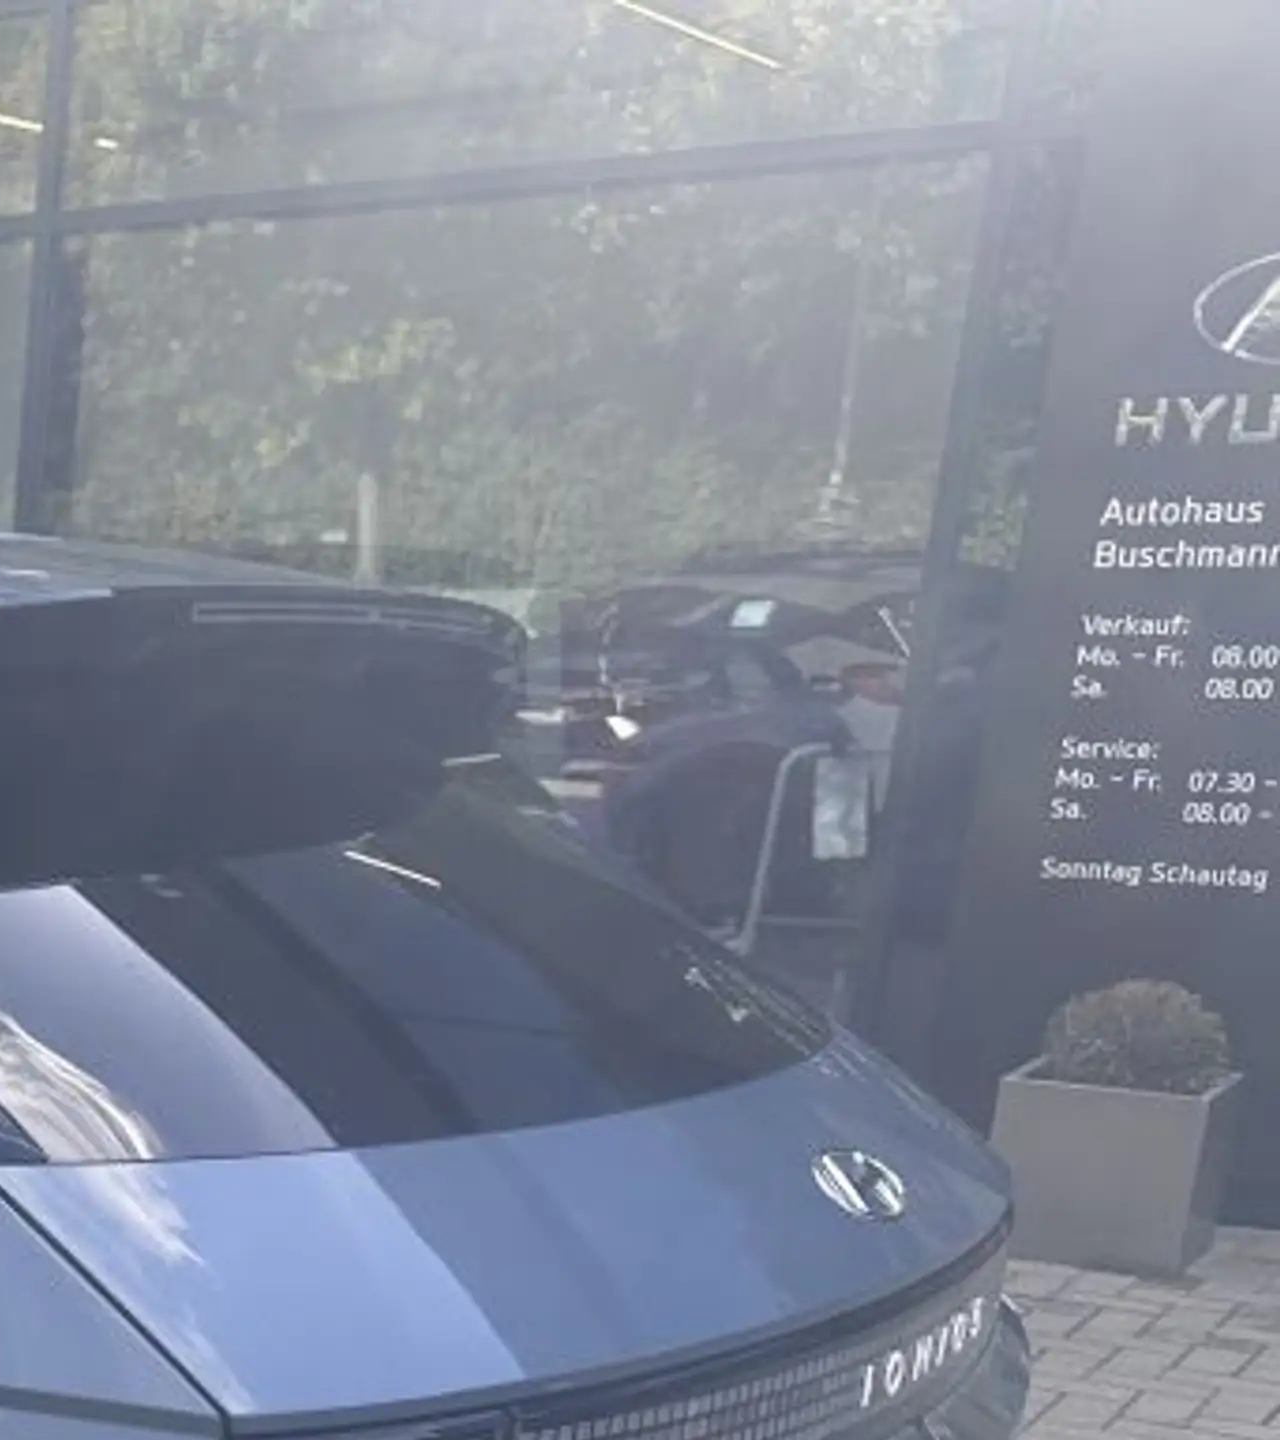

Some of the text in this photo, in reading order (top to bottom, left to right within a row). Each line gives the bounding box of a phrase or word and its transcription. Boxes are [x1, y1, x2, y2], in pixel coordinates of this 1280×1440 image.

[1099, 496, 1267, 527] Autohaus
[1080, 614, 1192, 636] Verkauf:
[1076, 645, 1121, 667] Mo.
[1154, 645, 1185, 668] Fr.
[1204, 677, 1274, 700] 08.00
[1060, 736, 1161, 760] Service:
[1054, 768, 1100, 789] Mo.
[1132, 769, 1161, 792] Fr.
[1187, 771, 1256, 794] 07.30
[1050, 797, 1087, 820] Sa.
[1181, 802, 1251, 825] 08.00
[1040, 856, 1269, 893] Sonntag Schautag
